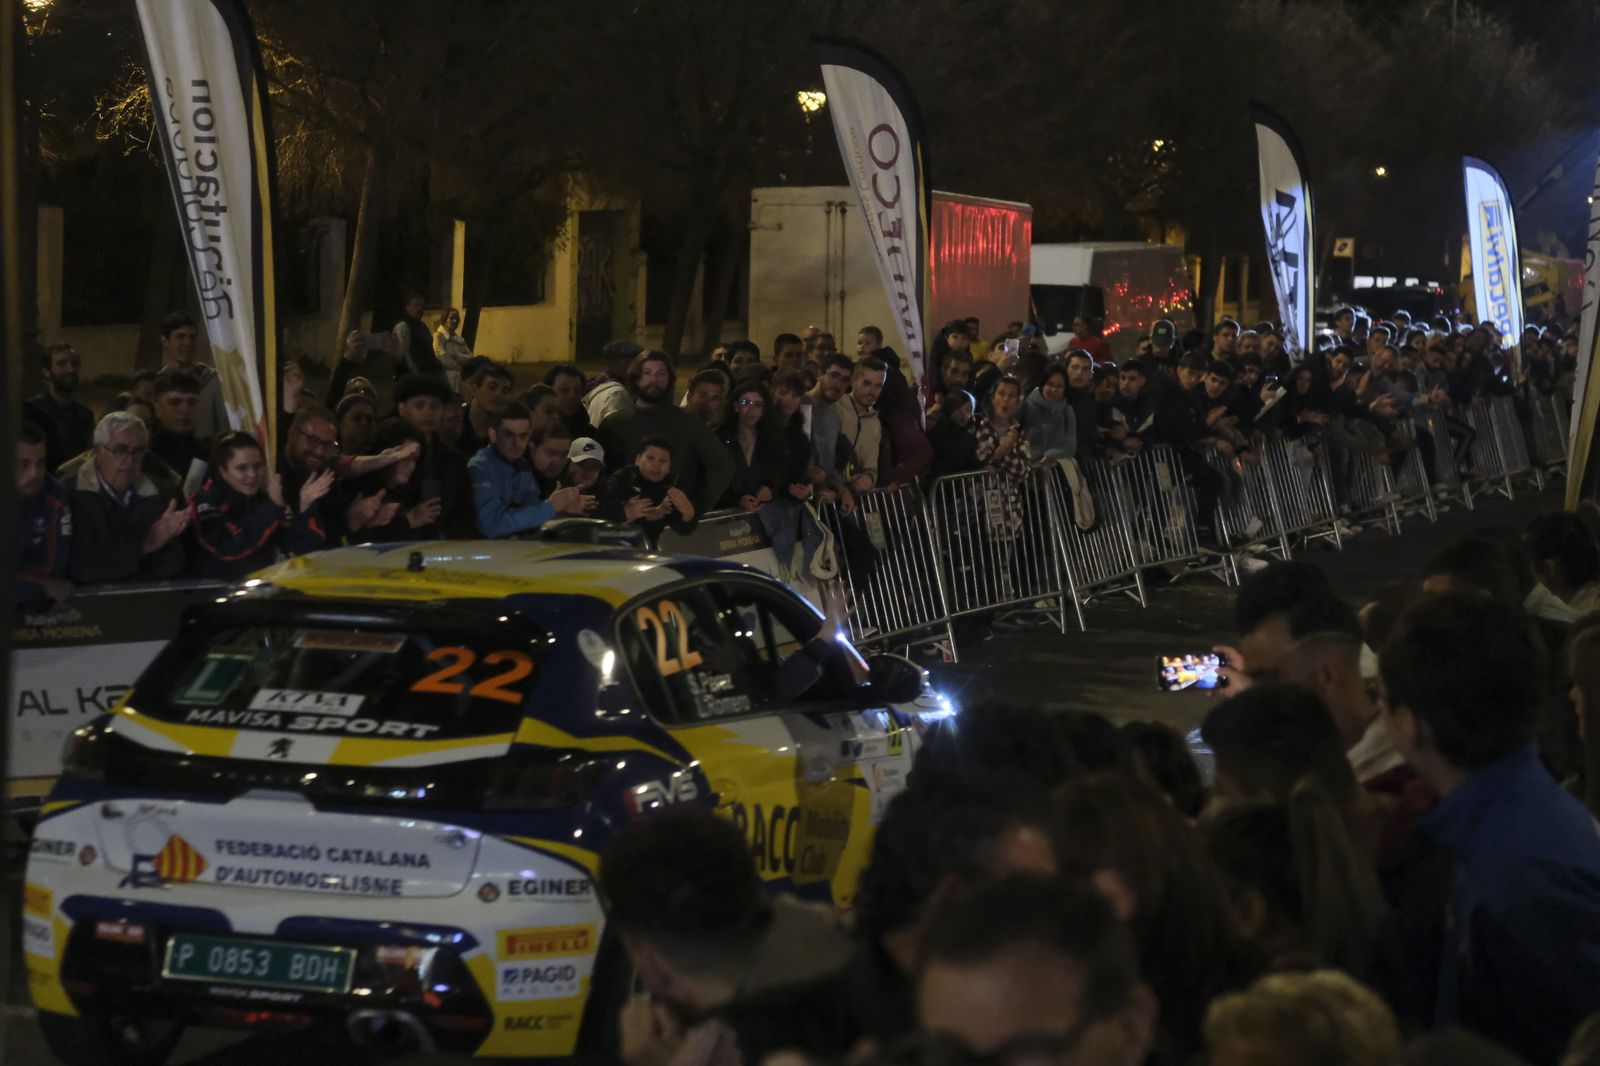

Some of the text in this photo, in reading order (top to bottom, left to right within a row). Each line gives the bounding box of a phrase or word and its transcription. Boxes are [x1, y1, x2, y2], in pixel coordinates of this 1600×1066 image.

[636, 600, 704, 677] 22
[410, 646, 534, 704] 22
[186, 708, 440, 739] MAVISA SPORT
[215, 839, 431, 869] FEDERACIÓ CATALANA
[215, 866, 404, 896] D'AUTOMOBILISME
[507, 877, 591, 897] EGINER
[506, 928, 590, 956] PIRELLI
[178, 944, 340, 983] P 0853 BDH
